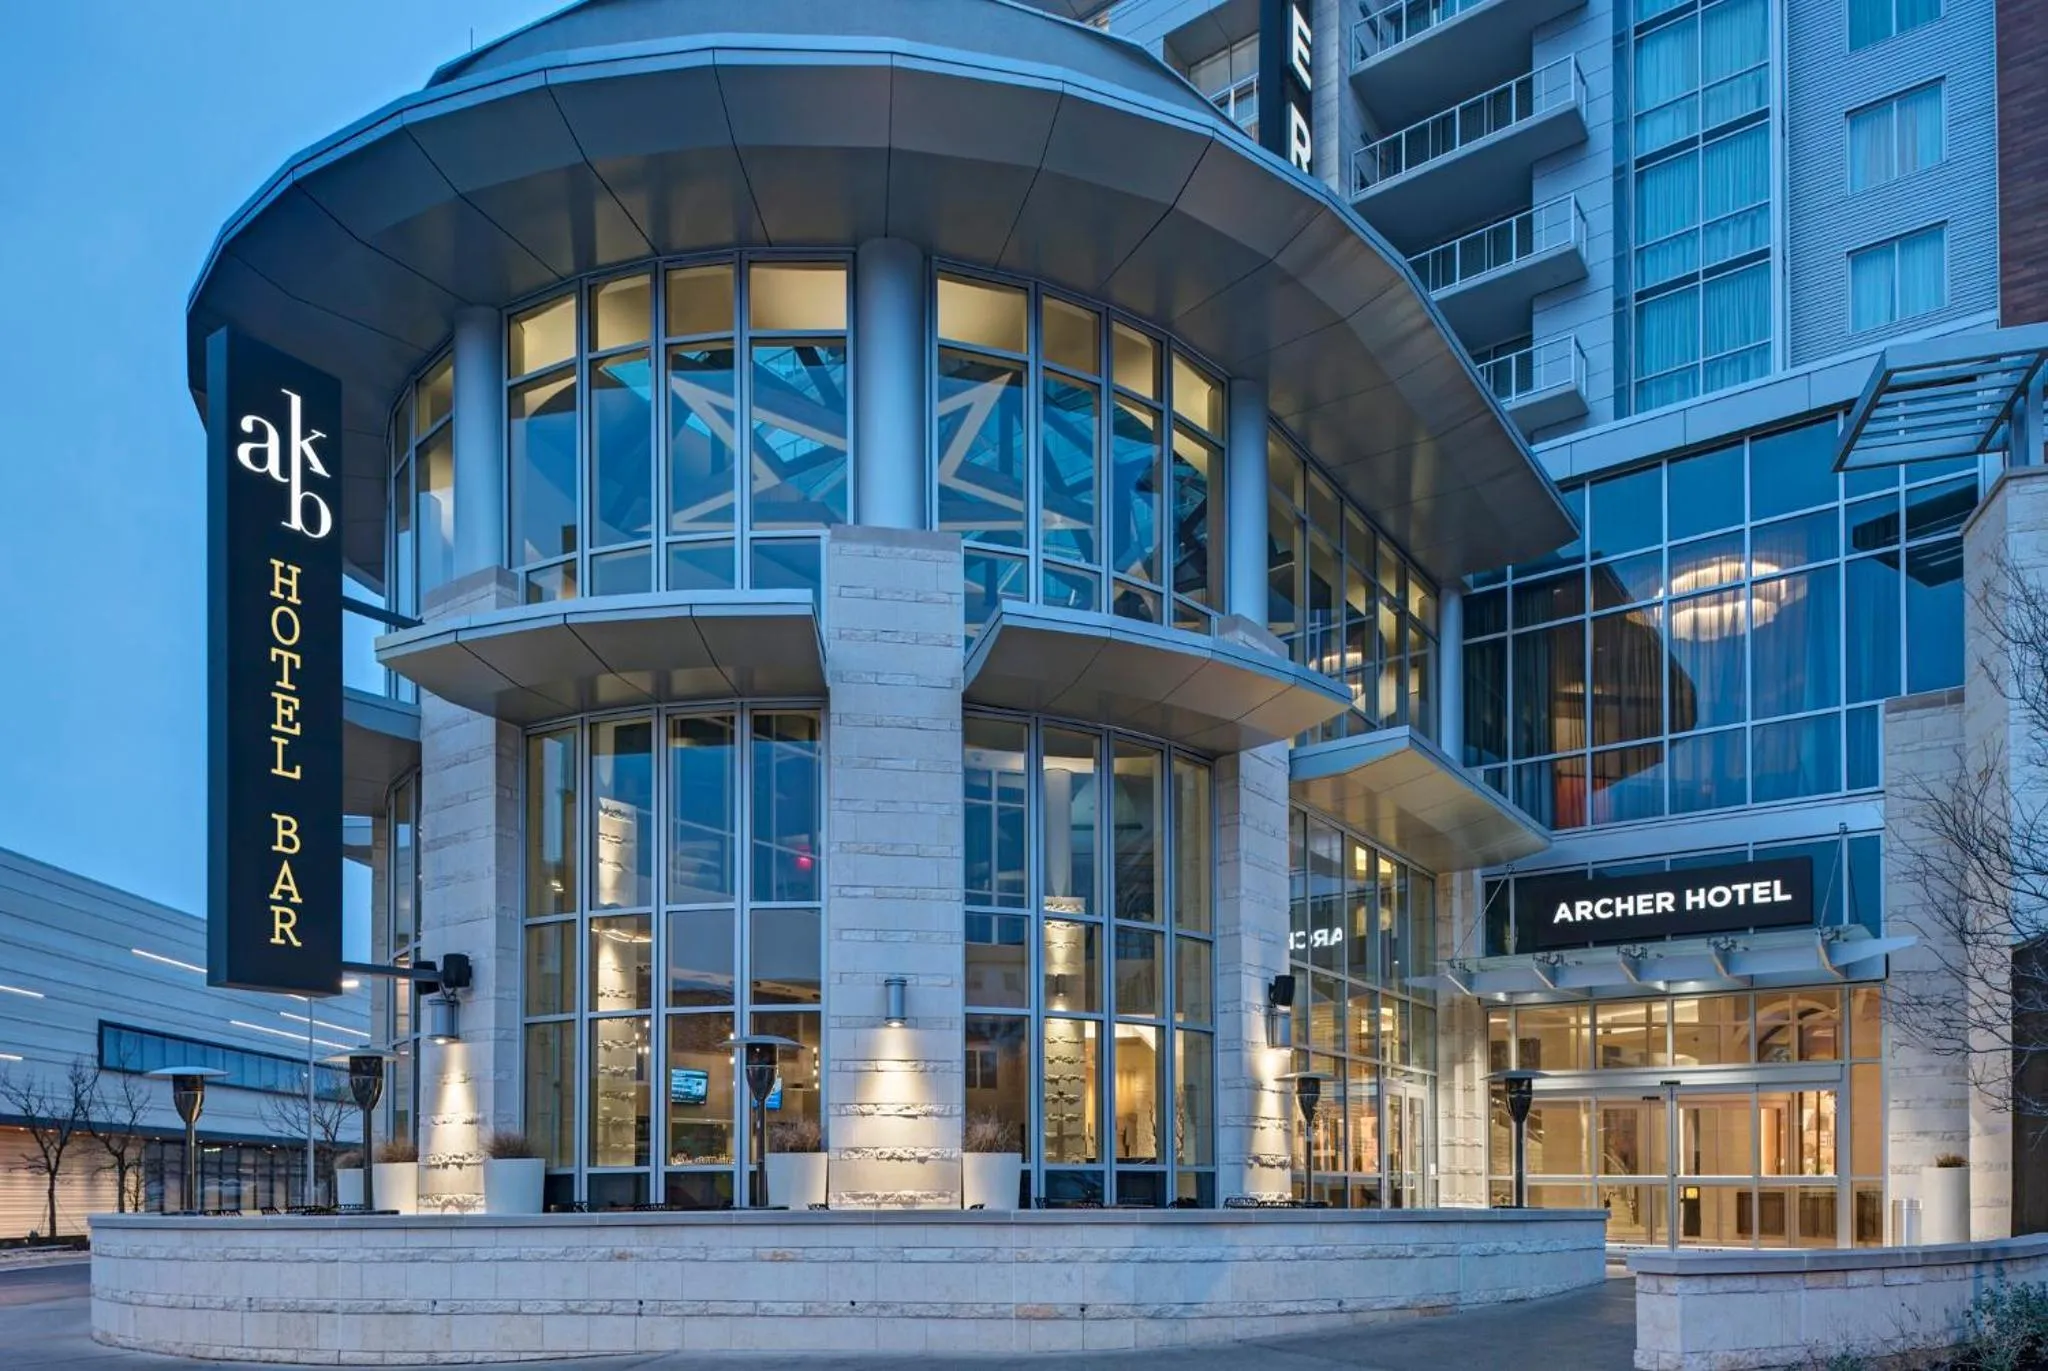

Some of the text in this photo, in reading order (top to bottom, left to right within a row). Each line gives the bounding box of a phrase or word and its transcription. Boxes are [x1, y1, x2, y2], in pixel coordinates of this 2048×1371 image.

[269, 558, 303, 947] HOTEL BAR
[1553, 879, 1793, 924] ARCHER HOTEL
